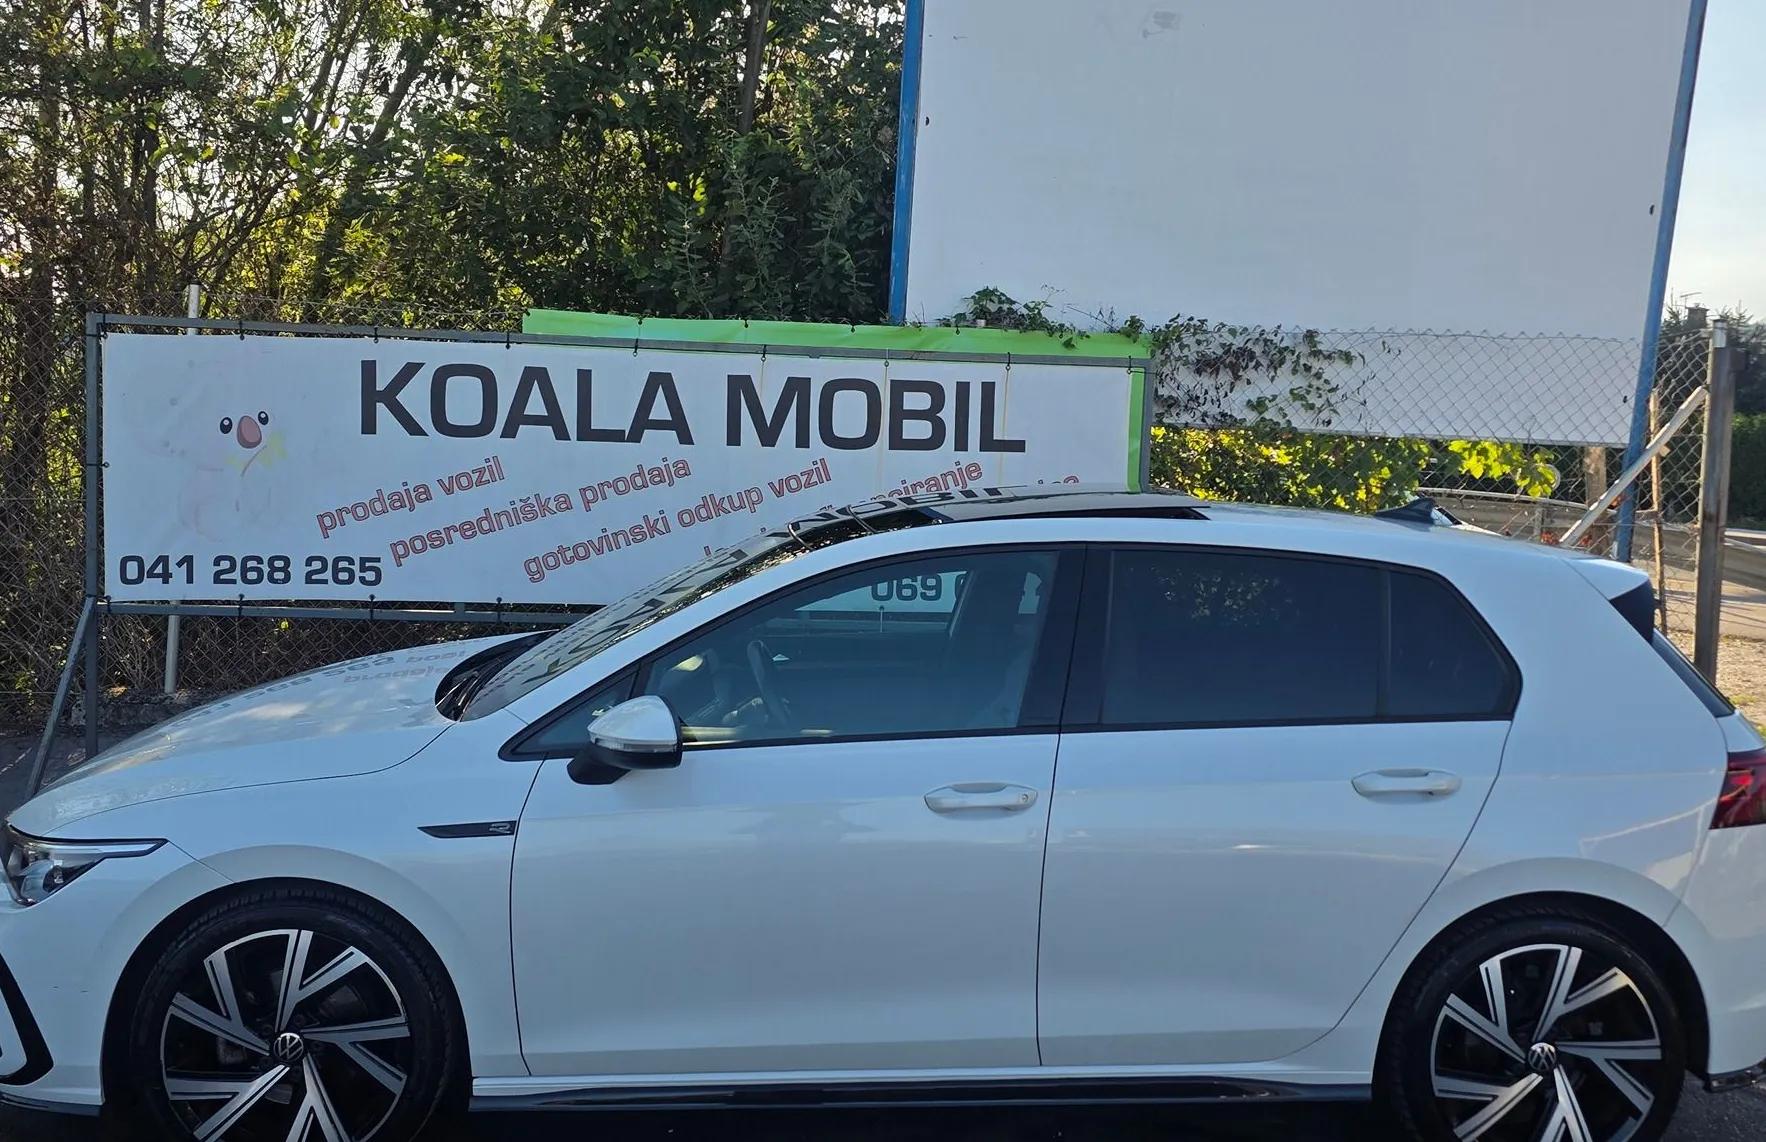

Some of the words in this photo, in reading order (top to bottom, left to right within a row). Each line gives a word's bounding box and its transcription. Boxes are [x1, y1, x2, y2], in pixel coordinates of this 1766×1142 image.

[360, 359, 695, 446] KOALA
[726, 374, 1027, 453] MOBIL
[316, 483, 433, 539] prodaja
[436, 455, 505, 496] vozil
[389, 493, 574, 567] posredniška
[579, 456, 692, 513] prodaja
[523, 510, 672, 583] gotovinski
[676, 485, 765, 530] odkup
[768, 457, 832, 498] vozil
[119, 554, 195, 586] 041
[212, 554, 292, 586] 268
[304, 555, 383, 587] 265
[871, 573, 943, 602] 069
